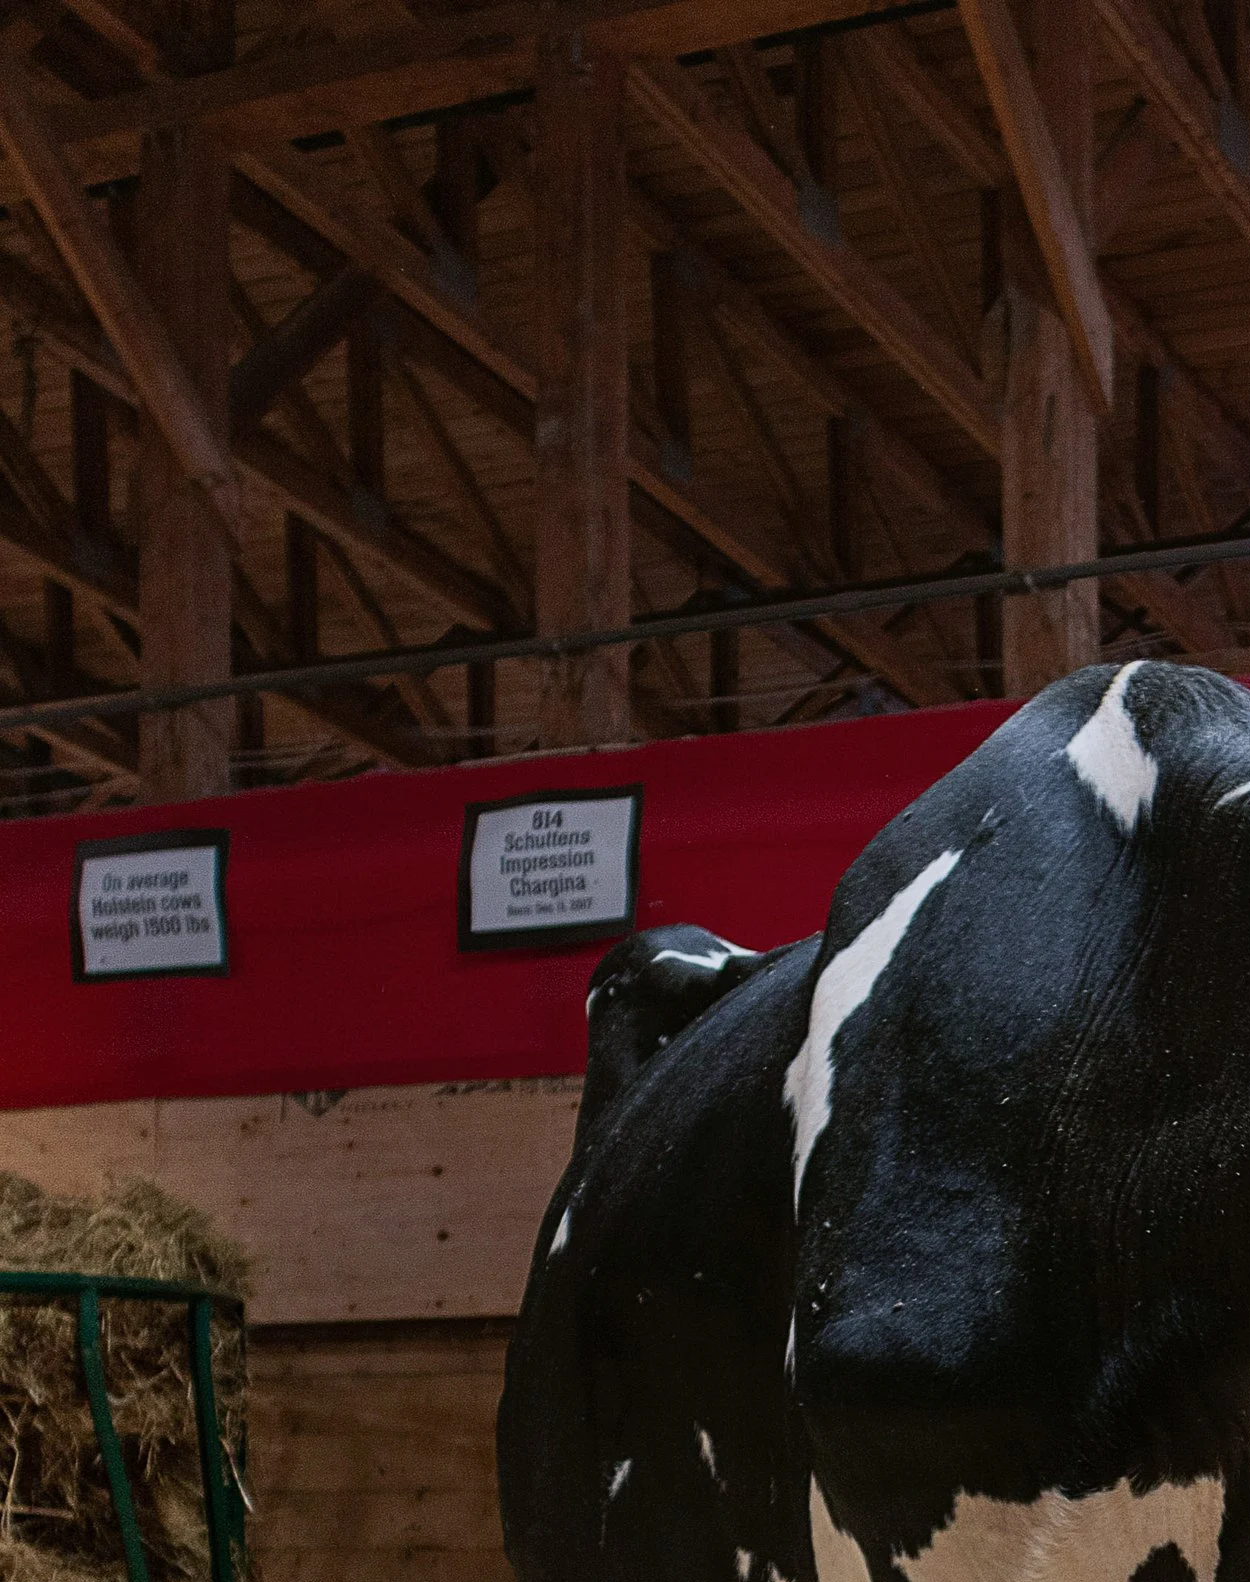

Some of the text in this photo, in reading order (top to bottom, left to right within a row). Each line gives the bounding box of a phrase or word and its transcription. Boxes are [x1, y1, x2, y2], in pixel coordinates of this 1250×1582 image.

[533, 810, 563, 829] 814
[501, 850, 594, 875] Impression
[102, 871, 188, 892] On average
[92, 894, 201, 917] Holstein cows
[92, 920, 139, 942] weigh
[143, 915, 181, 937] 1500
